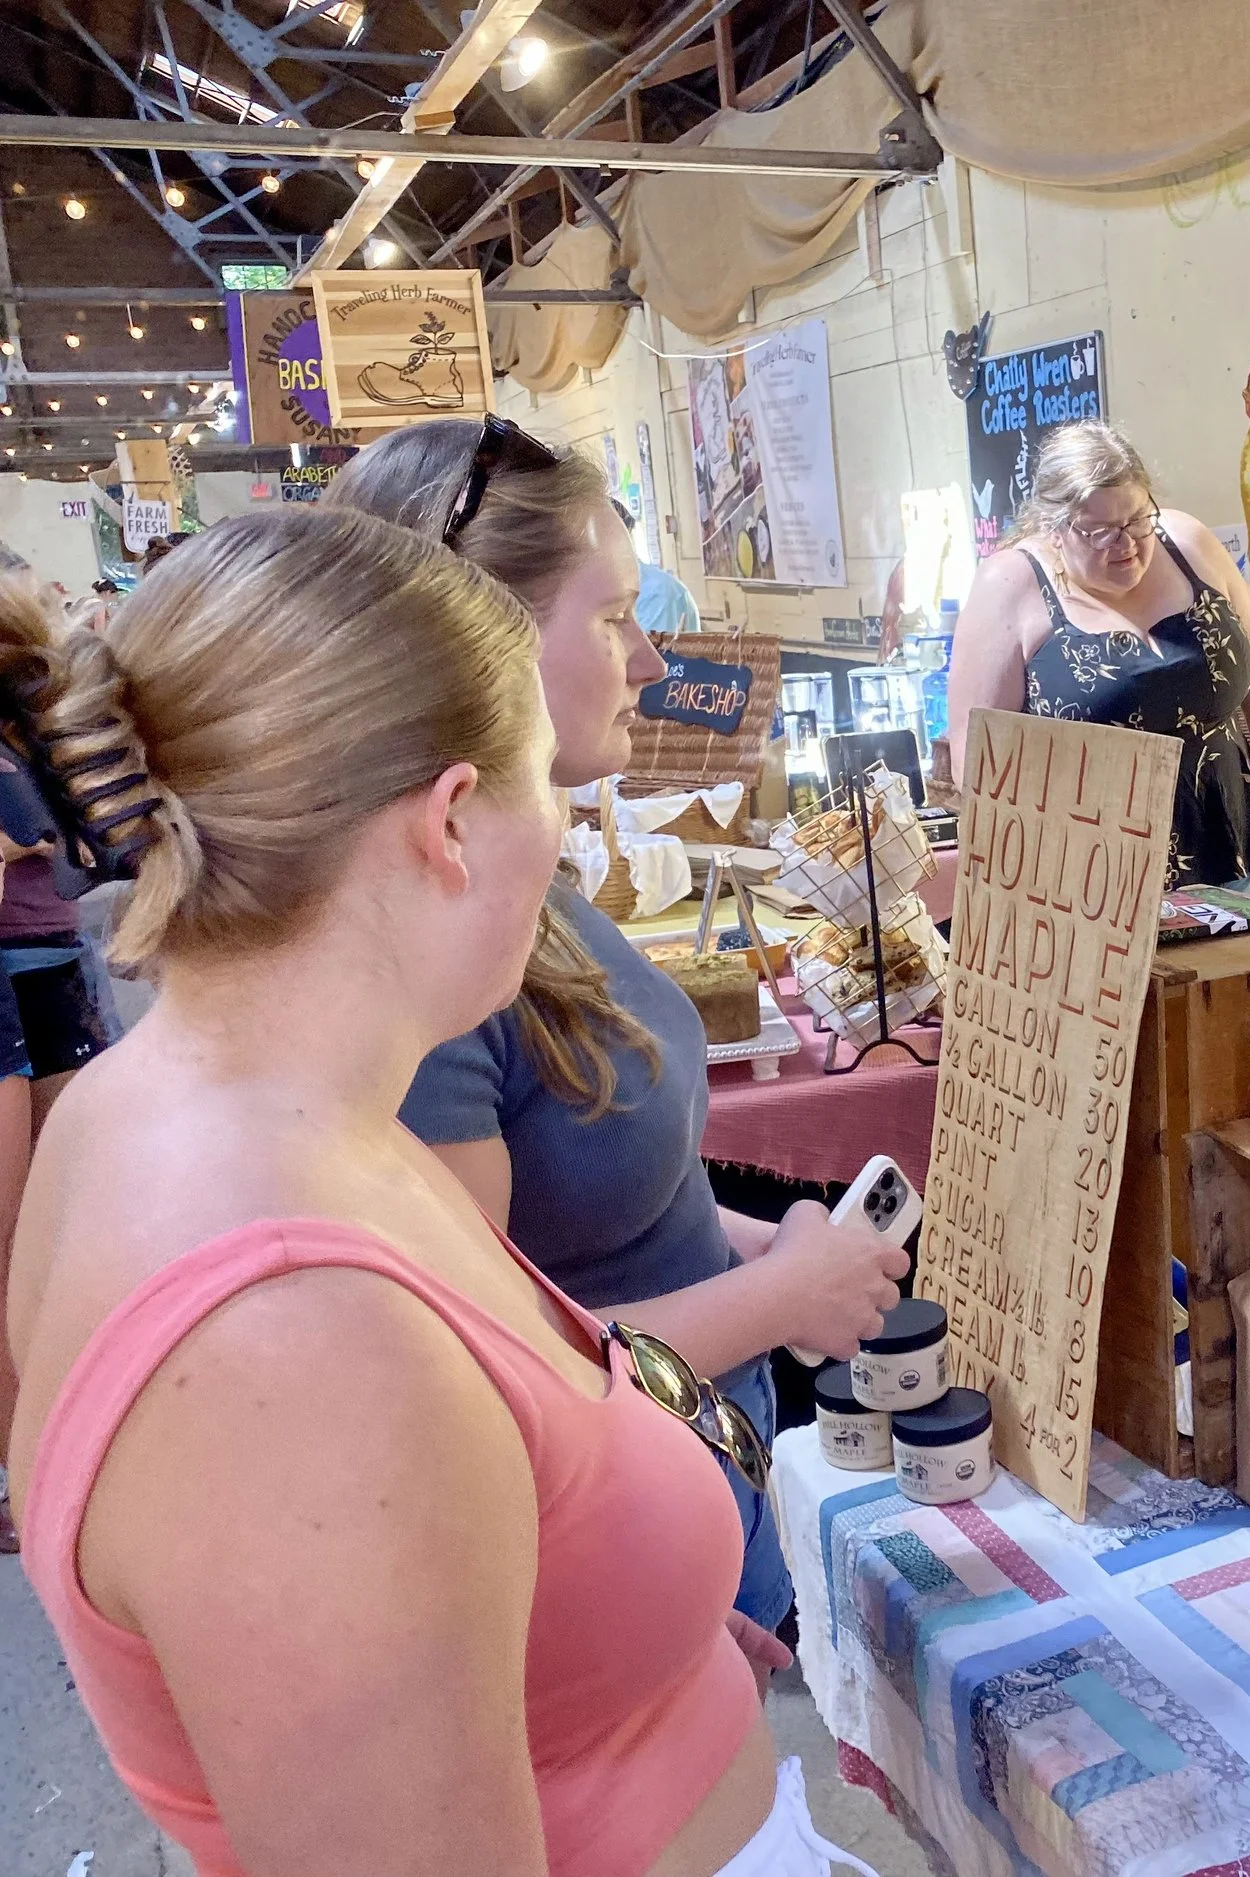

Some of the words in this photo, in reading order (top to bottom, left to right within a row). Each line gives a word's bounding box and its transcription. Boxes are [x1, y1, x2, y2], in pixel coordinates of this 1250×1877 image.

[257, 300, 317, 366] HANDC
[330, 287, 389, 322] Traveling
[391, 284, 423, 305] Herb
[425, 287, 472, 316] Farmer
[984, 354, 1028, 402] Chatty
[1032, 351, 1072, 388] Wren
[981, 394, 1028, 435] Coffee
[1033, 386, 1098, 426] Roasters
[62, 502, 88, 518] EXIT
[127, 505, 167, 519] FARM
[128, 520, 169, 534] FRESH
[974, 515, 998, 539] What
[663, 680, 747, 717] BAKESHOP
[972, 717, 1153, 839] MILL
[964, 800, 1150, 933] HOLLOW
[954, 885, 1130, 1031] MAPLE
[953, 976, 1061, 1060] GALLON
[1092, 1035, 1128, 1088] 50
[967, 1037, 1068, 1121] GALLON
[1083, 1086, 1119, 1145] 30
[942, 1075, 1026, 1153] QUART
[1074, 1145, 1113, 1201] 20
[935, 1128, 998, 1191] PINT
[1072, 1199, 1100, 1254] 13
[930, 1173, 1005, 1255] SUGAR
[1066, 1253, 1094, 1308] 10
[926, 1225, 1011, 1315] CREAM
[1068, 1319, 1086, 1364] 8
[950, 1342, 996, 1396] NDY
[1020, 1403, 1037, 1450] 4
[1039, 1429, 1061, 1458] FOR
[1060, 1431, 1078, 1482] 2
[1056, 1365, 1082, 1421] 15
[840, 1422, 882, 1432] HOLLOW
[904, 1450, 947, 1469] HOLLOW
